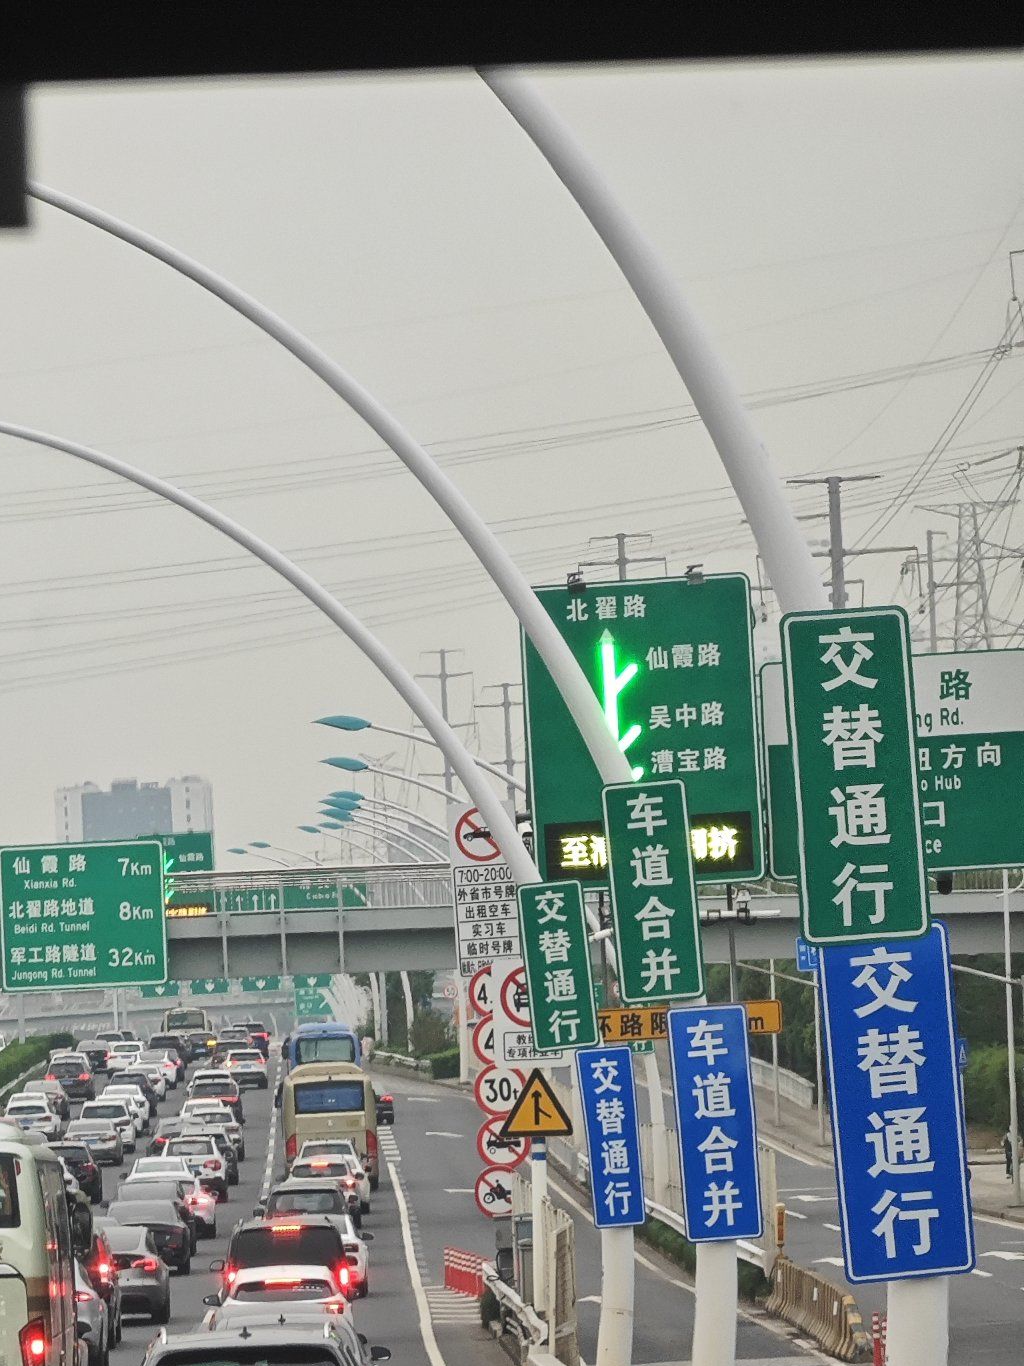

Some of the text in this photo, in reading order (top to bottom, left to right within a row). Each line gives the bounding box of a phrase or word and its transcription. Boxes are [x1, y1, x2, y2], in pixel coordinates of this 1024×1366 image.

[566, 595, 646, 621] 北翟路
[646, 643, 721, 670] 仙霞路
[649, 701, 725, 729] 吴中路
[940, 708, 964, 726] Rd.
[651, 746, 727, 773] 漕宝路
[818, 627, 893, 927] 交替通行
[934, 775, 962, 791] Hub
[12, 853, 86, 875] 仙霞路
[458, 867, 512, 884] 7:00-20:00
[24, 878, 77, 890] Xianxia Rd.
[457, 884, 517, 902] 外省市号牌
[626, 793, 681, 992] 车道合并
[8, 897, 95, 920] 北翟路地道
[465, 903, 512, 919] 出租空车
[14, 920, 90, 935] Beidi Rd. Tunnel
[472, 921, 507, 937] 实习车
[10, 943, 97, 966] 军工路隧道
[467, 940, 514, 955] 临时号牌
[12, 966, 97, 982] Jungong Rd. Tunnel
[535, 890, 580, 1043] 交替通行
[851, 946, 939, 1259] 交替通行
[686, 1019, 743, 1228] 车道合并
[591, 1058, 632, 1217] 交替通行
